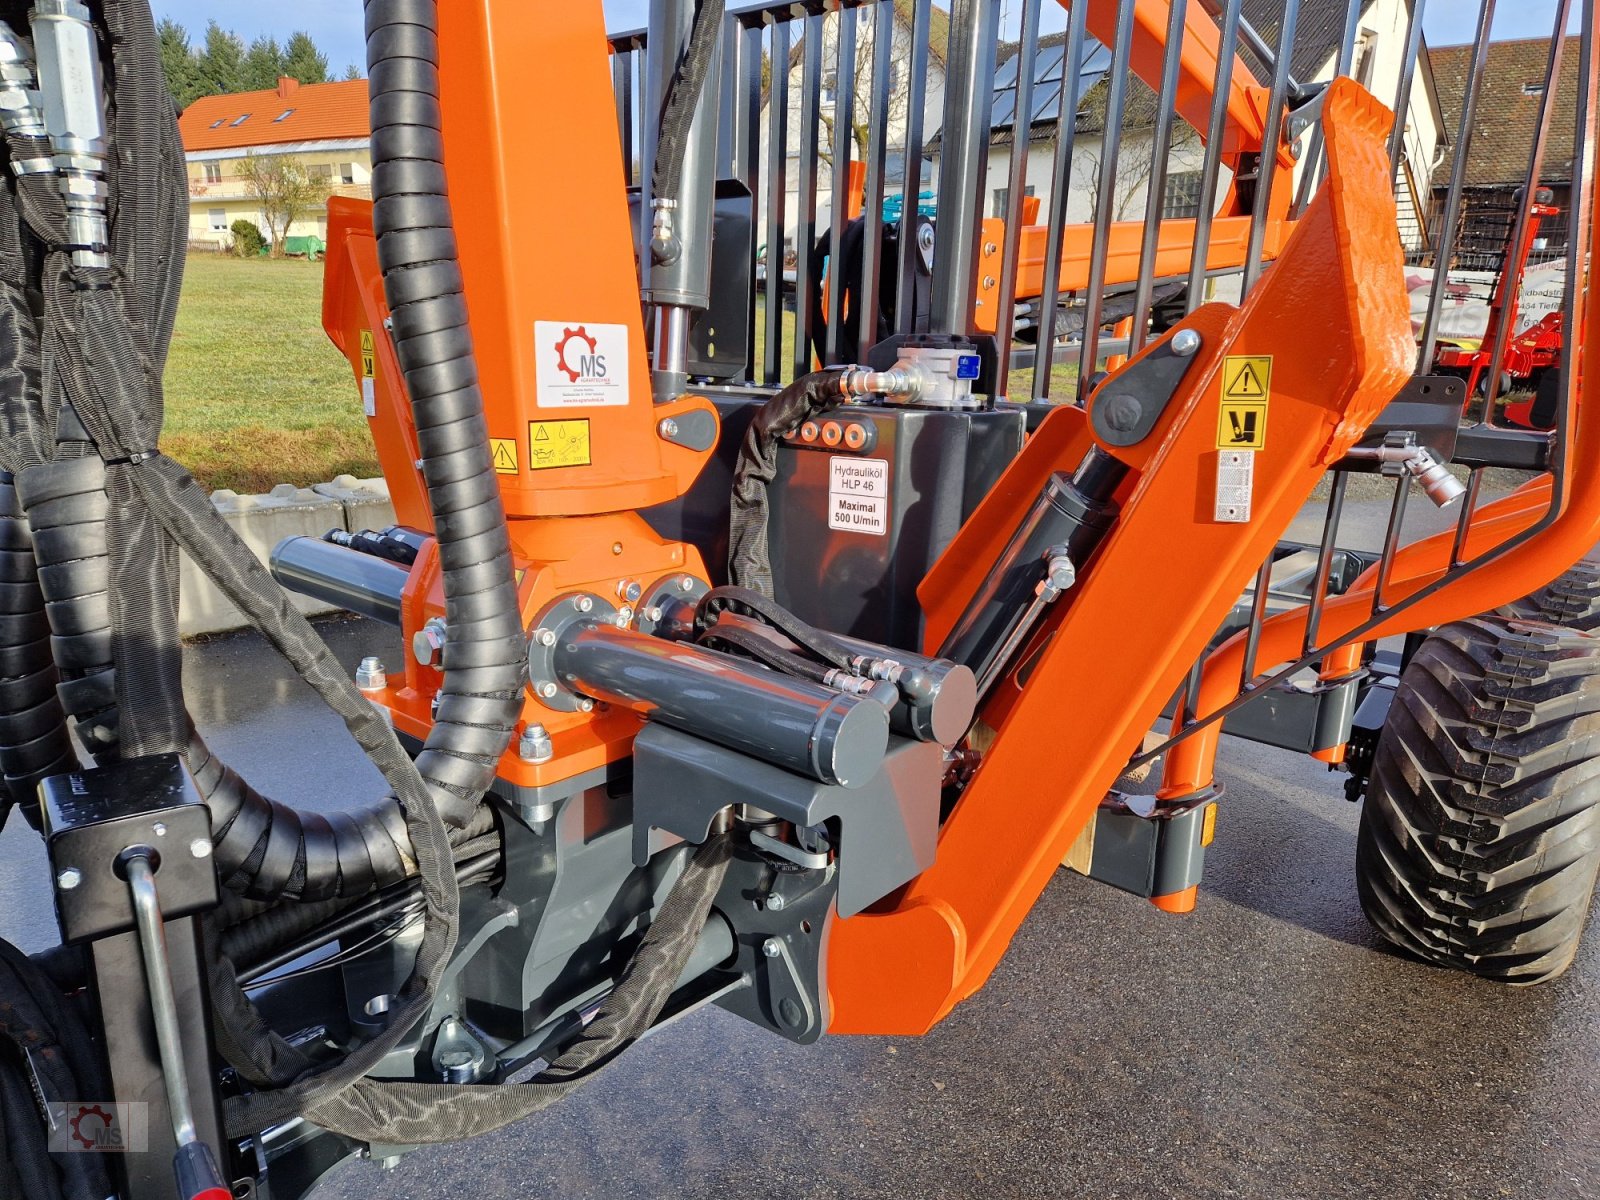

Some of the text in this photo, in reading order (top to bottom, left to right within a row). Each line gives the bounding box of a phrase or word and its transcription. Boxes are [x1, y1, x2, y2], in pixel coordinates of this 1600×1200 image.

[580, 354, 607, 378] MS
[834, 465, 882, 478] Hydrauliköl
[841, 479, 874, 491] HLP 46
[839, 499, 876, 512] Maximal
[834, 512, 880, 526] 500 U/min
